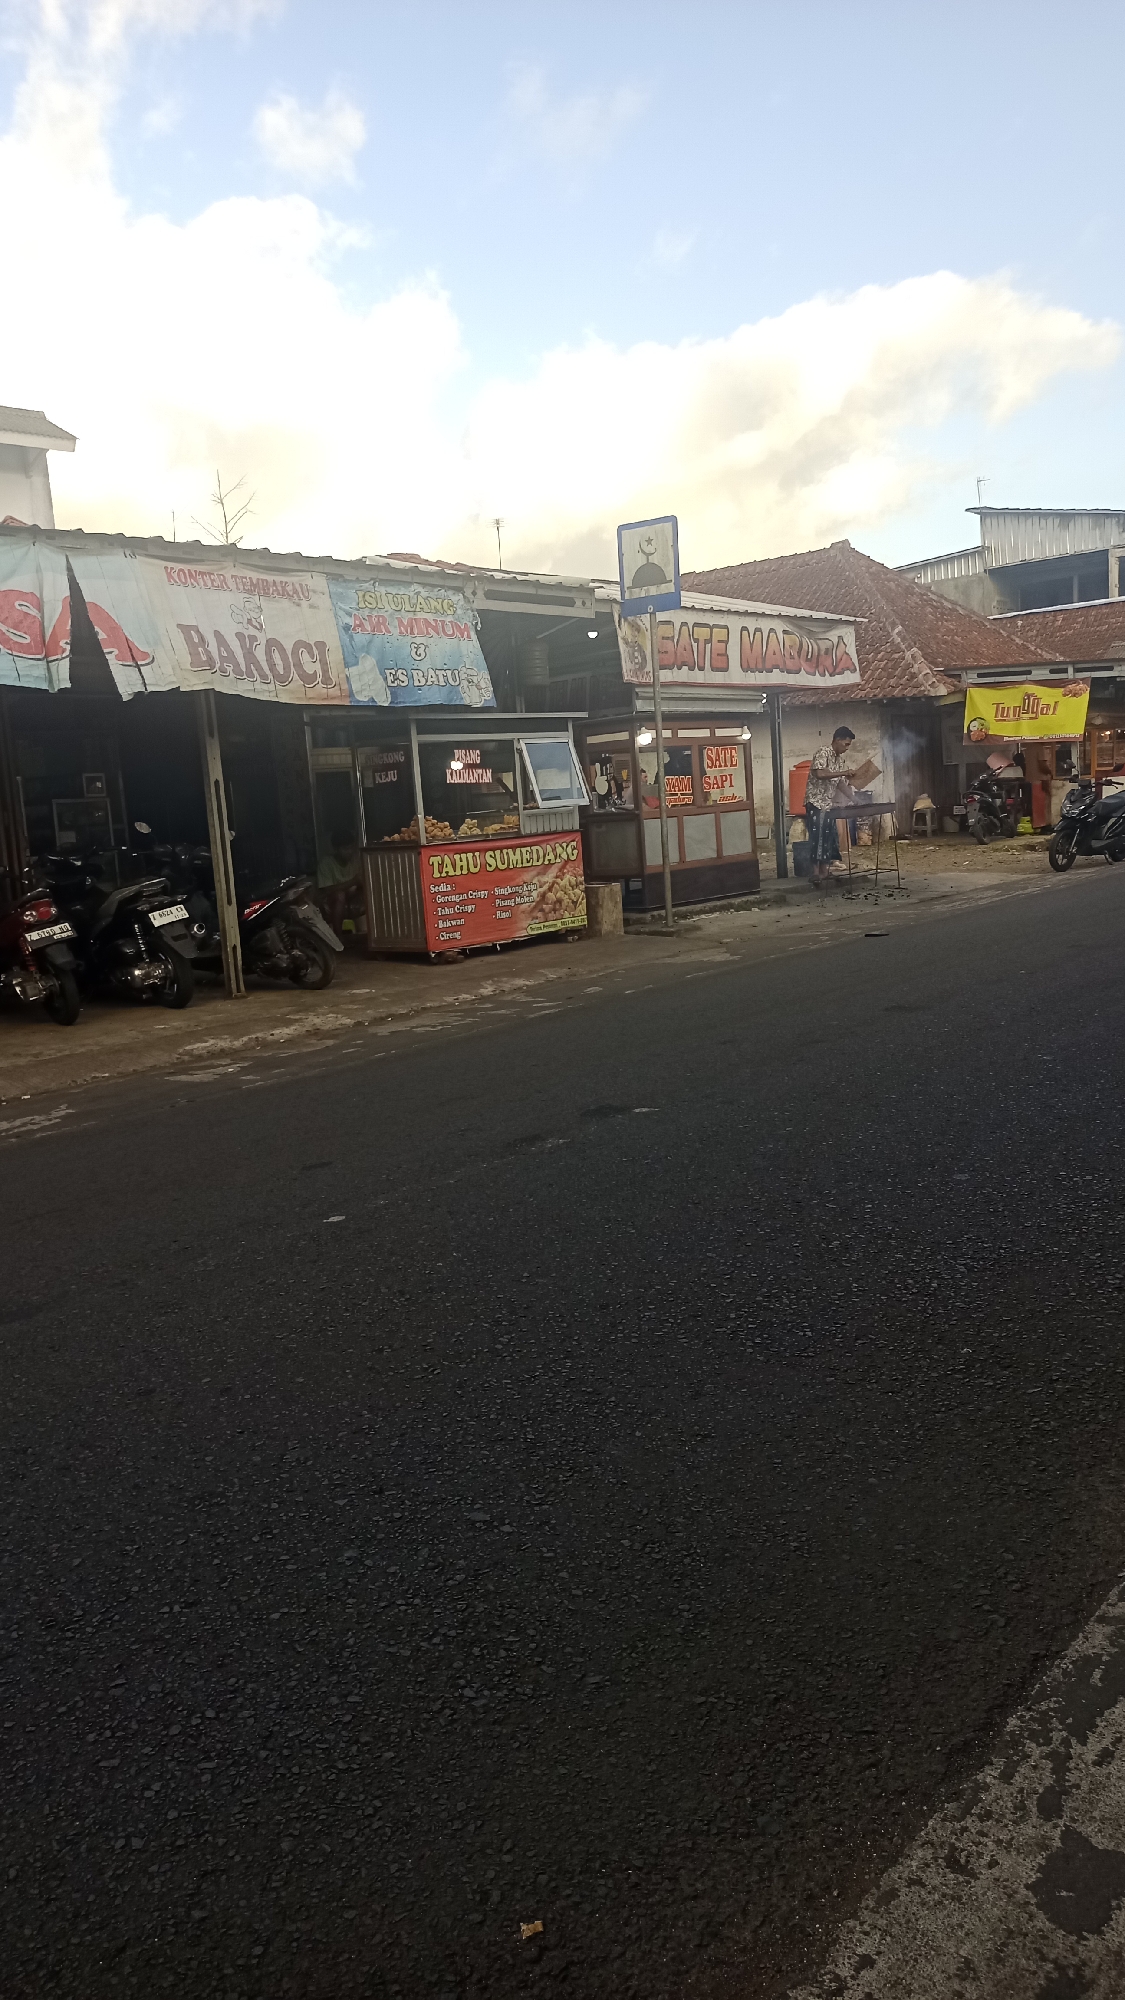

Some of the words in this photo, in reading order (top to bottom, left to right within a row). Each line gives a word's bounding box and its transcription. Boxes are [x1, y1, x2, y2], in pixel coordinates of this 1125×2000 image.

[164, 566, 232, 591] KONTER
[231, 575, 311, 600] TEMBAKAU
[356, 590, 385, 609] ISI
[385, 593, 456, 615] ULANG
[352, 613, 392, 635] AIR
[396, 617, 473, 642] MINUM
[656, 620, 730, 672] SATE
[177, 624, 336, 688] BAKOCI
[385, 668, 409, 687] ES
[411, 668, 460, 687] BATU
[454, 750, 481, 763] PISANG
[705, 746, 738, 770] SATE
[375, 770, 398, 783] KEJU
[446, 769, 492, 783] KALIMANTAN
[703, 773, 734, 792] SAPI
[429, 851, 482, 879] TAHU
[485, 840, 579, 872] SUMEDANG
[430, 883, 451, 893] Sedia
[494, 885, 523, 895] Singkong
[436, 893, 467, 903] Gorengan
[468, 889, 488, 899] Crispy
[495, 899, 514, 907] Pisang
[437, 907, 454, 916] Tahu
[455, 904, 476, 914] Crispy
[438, 918, 465, 928] Bakwan
[439, 931, 461, 940] Cireng
